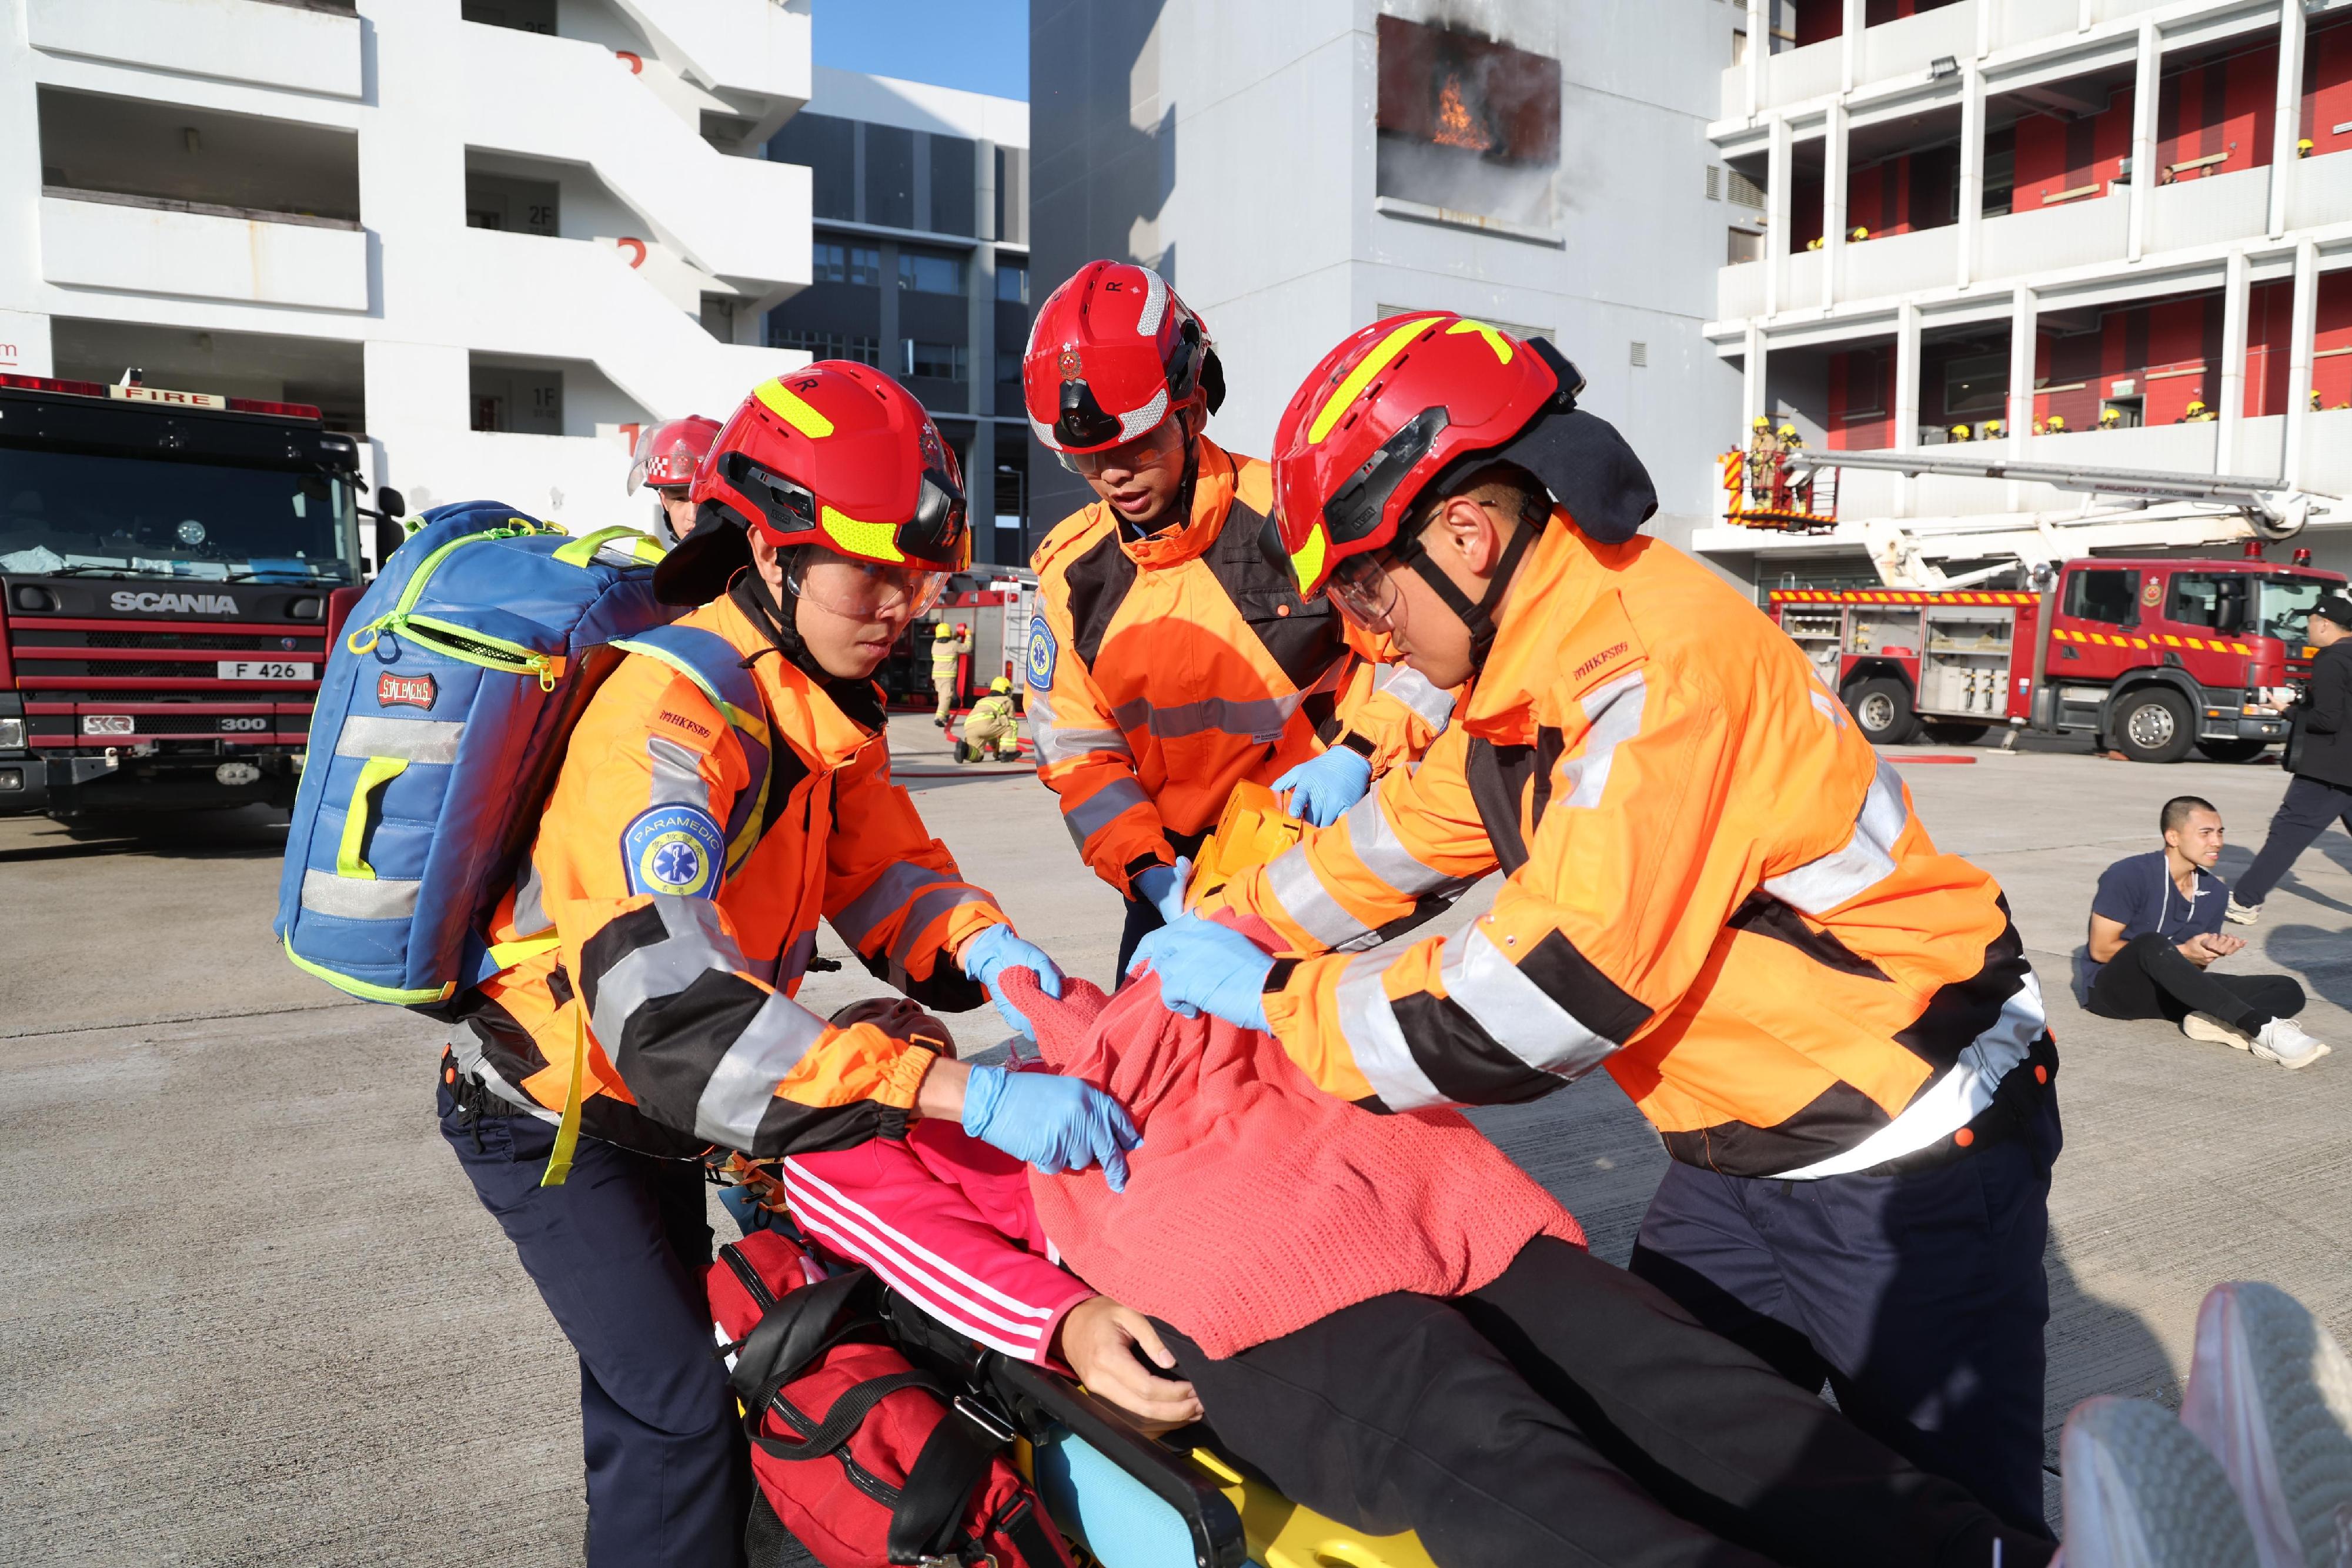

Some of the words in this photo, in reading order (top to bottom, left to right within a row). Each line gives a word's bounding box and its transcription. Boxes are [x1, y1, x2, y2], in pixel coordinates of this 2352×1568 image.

[529, 206, 551, 225] 2F
[1105, 282, 1123, 292] R
[795, 378, 818, 393] R
[125, 387, 211, 406] FIRE
[534, 387, 555, 406] 1F
[110, 591, 239, 614] SCANIA
[236, 664, 248, 677] F
[259, 664, 296, 678] 426
[221, 718, 266, 731] 300
[634, 817, 720, 850] PARAMEDIC
